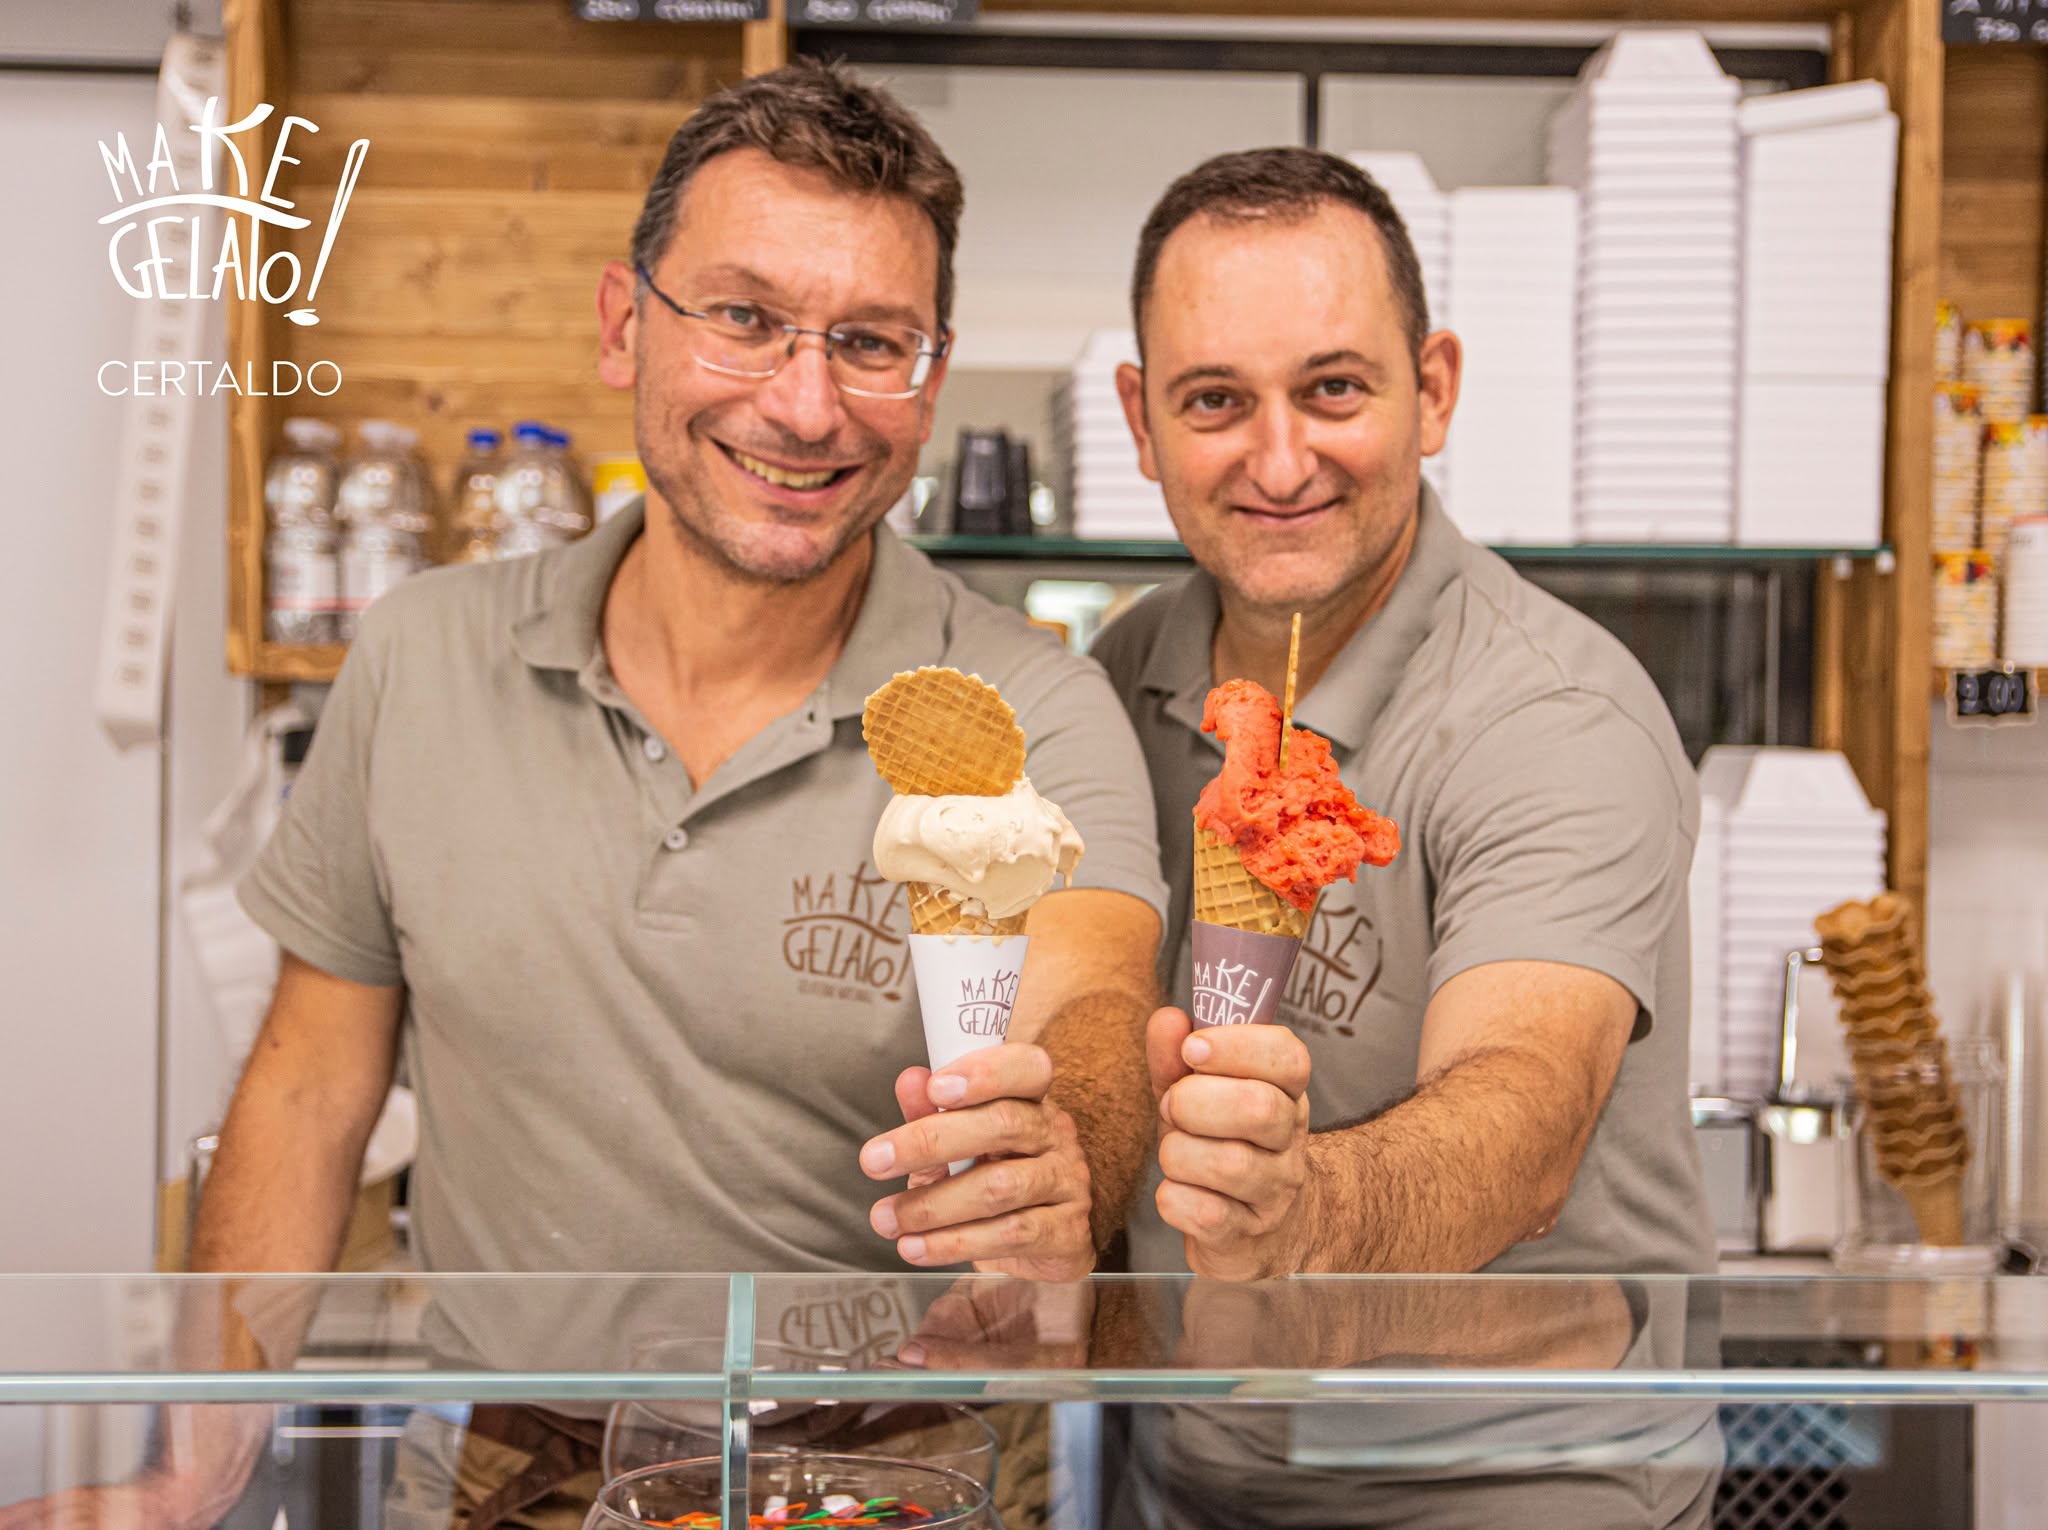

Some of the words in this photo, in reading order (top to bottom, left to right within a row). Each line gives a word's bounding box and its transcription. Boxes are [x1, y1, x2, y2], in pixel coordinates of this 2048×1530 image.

[792, 860, 905, 933] MAKE
[1307, 891, 1373, 967] KE
[961, 969, 1018, 1004] MAKE
[1194, 958, 1259, 1001] MAKE
